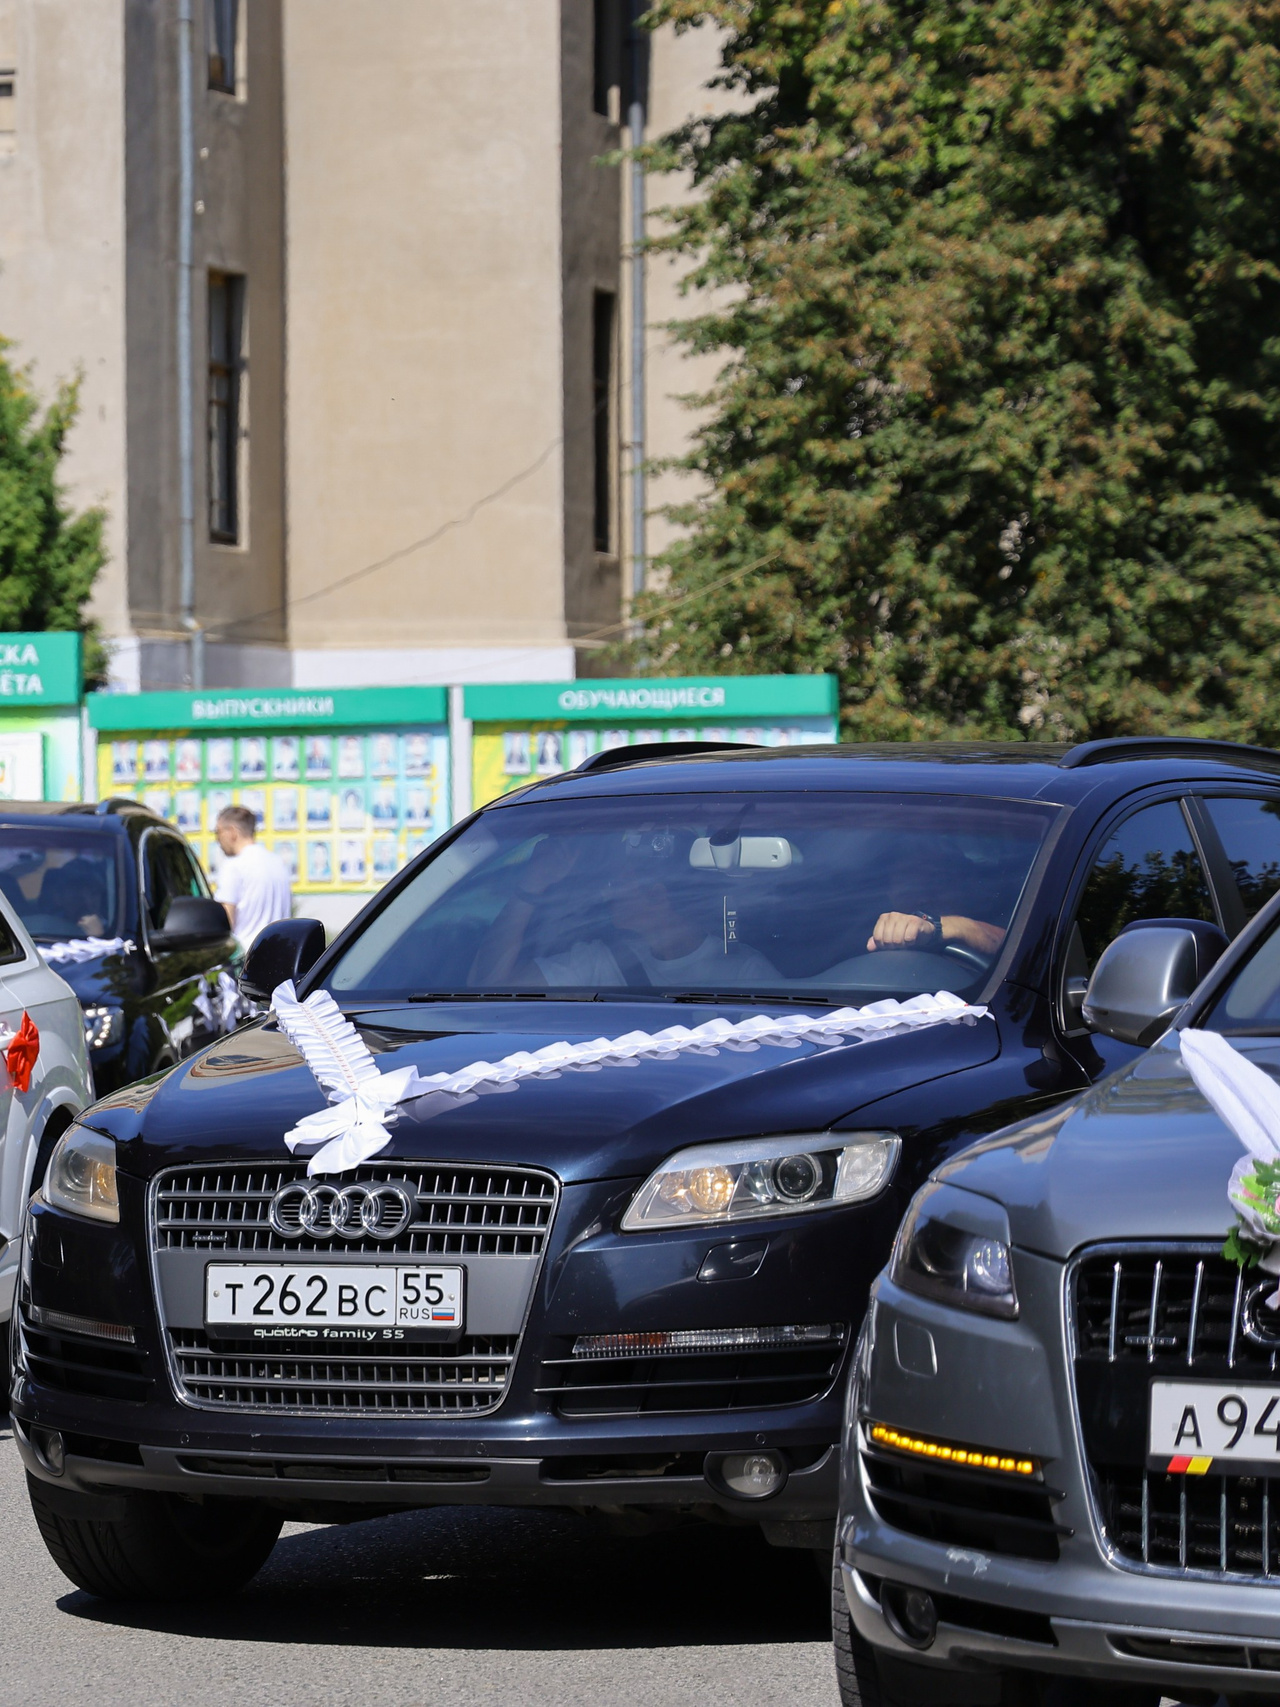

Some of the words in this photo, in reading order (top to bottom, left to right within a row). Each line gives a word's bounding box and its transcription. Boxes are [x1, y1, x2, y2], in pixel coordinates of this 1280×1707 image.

[192, 696, 335, 720] ВЫПУСКНИКИ
[558, 687, 726, 711] ОБУЧАЮЩИЕСЯ
[403, 1273, 445, 1306] 55
[400, 1307, 430, 1321] RUS
[254, 1328, 319, 1340] quattro
[322, 1329, 376, 1341] family
[383, 1329, 405, 1340] 55
